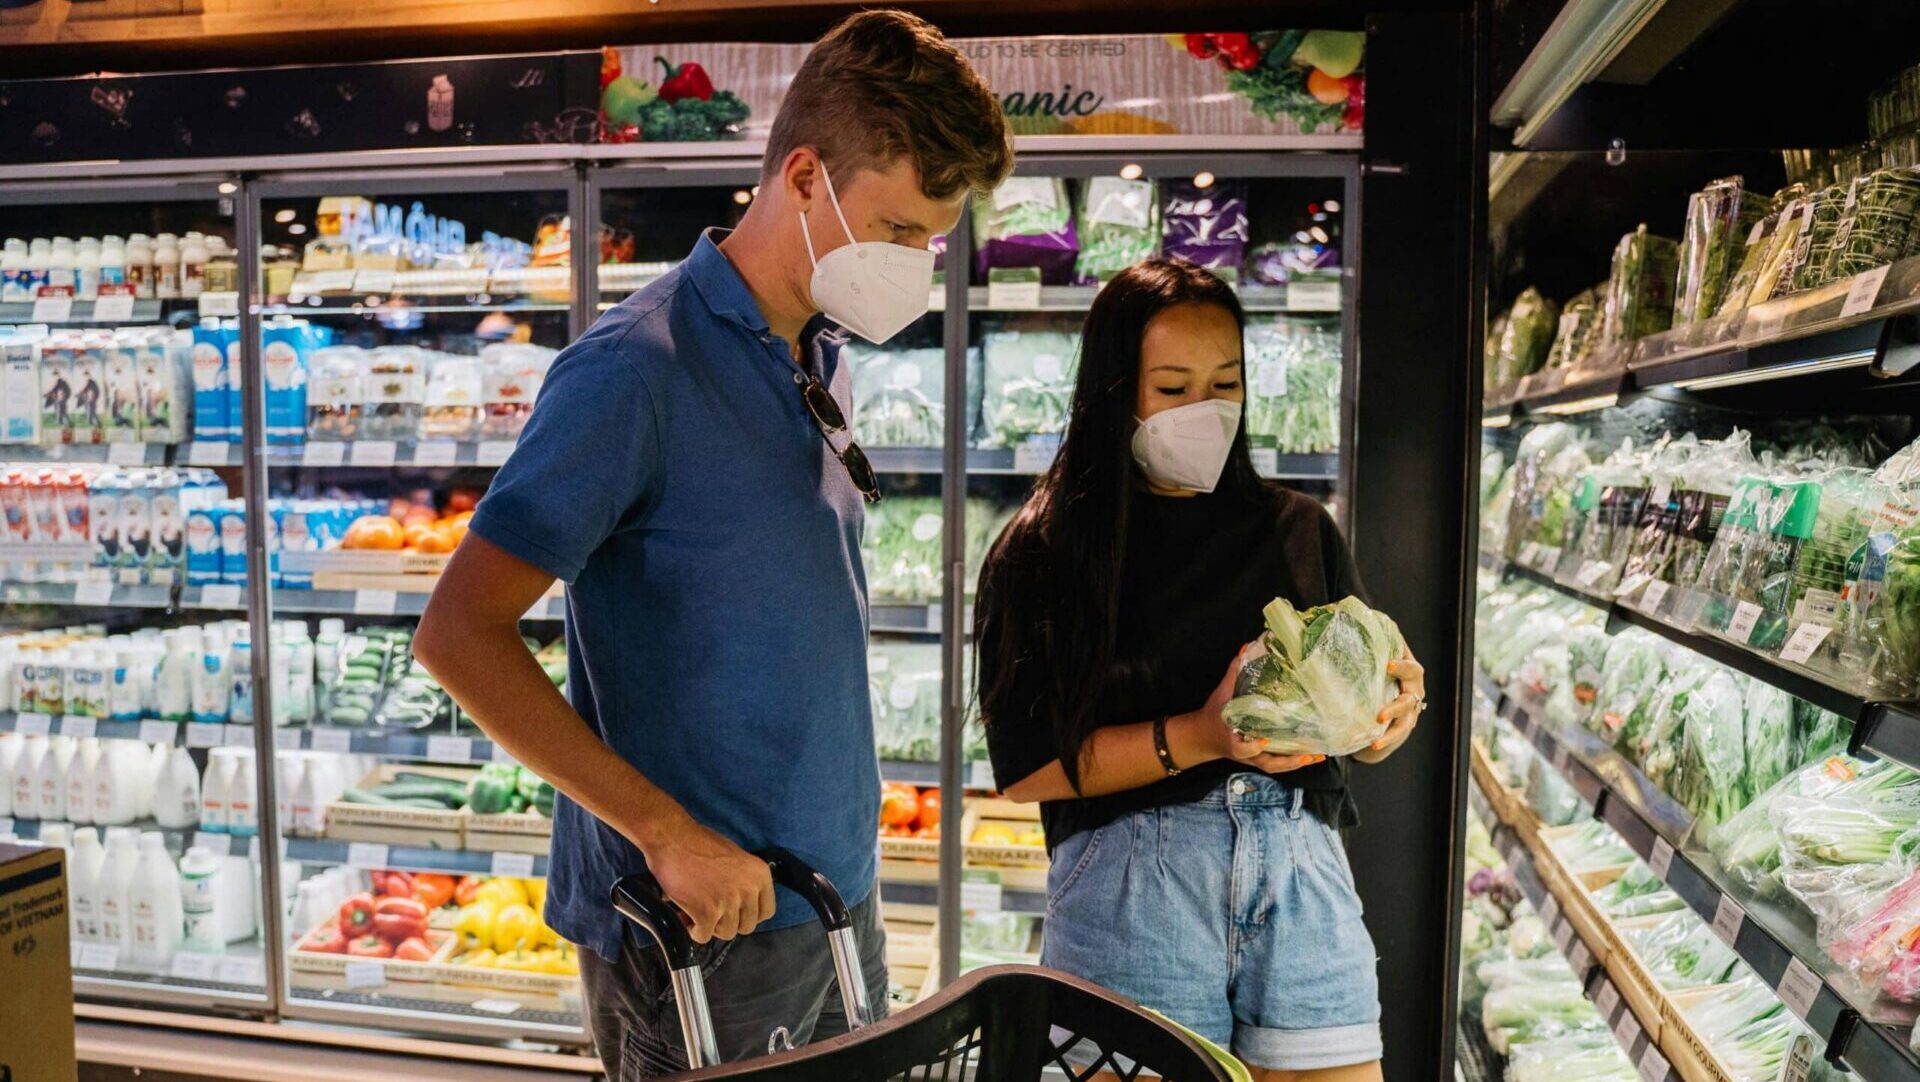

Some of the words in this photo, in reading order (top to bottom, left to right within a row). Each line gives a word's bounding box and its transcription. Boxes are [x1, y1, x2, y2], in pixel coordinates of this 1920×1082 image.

[997, 44, 1014, 58] TO
[1021, 43, 1039, 58] BE
[1046, 42, 1127, 58] CERTIFIED
[1000, 84, 1103, 117] anic
[17, 903, 63, 928] VIETNAM
[1663, 1006, 1693, 1048] ANNAM
